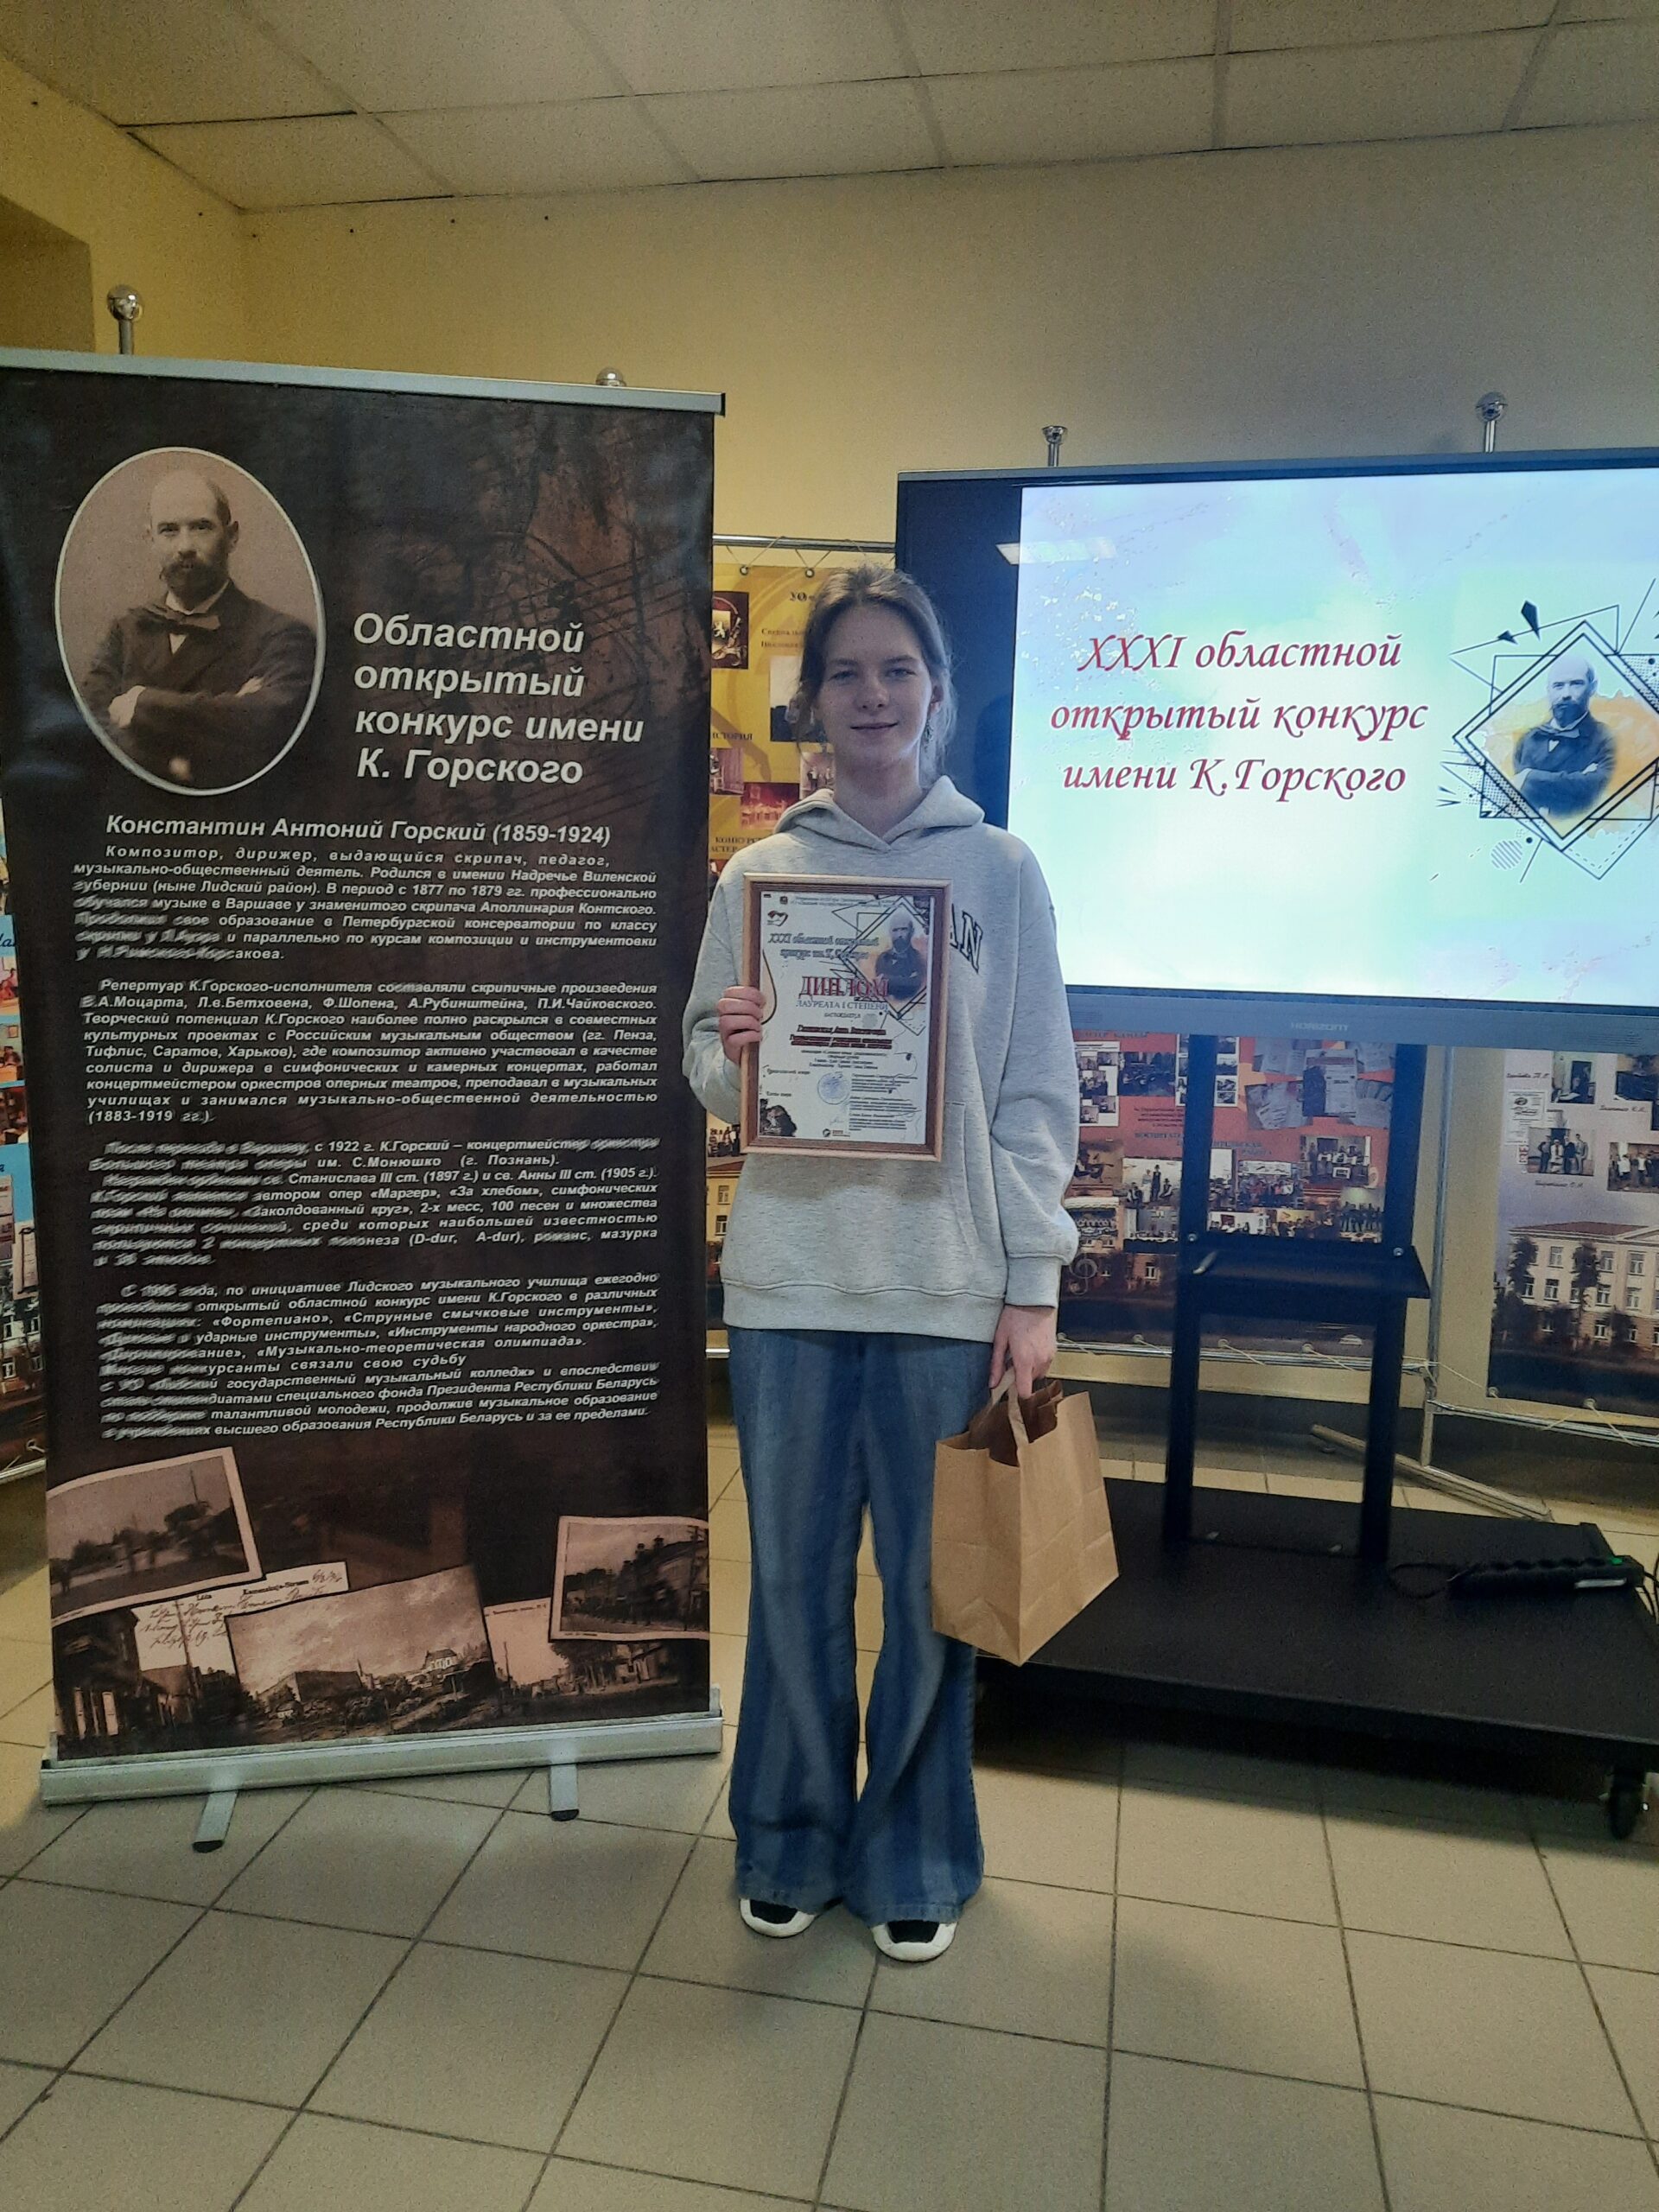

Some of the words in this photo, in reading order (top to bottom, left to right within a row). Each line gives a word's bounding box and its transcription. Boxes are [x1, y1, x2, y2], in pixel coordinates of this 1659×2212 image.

[353, 613, 585, 652] Областной
[1077, 634, 1187, 671] XXXI
[1195, 630, 1402, 668] областной
[353, 664, 586, 699] открытый
[355, 710, 513, 745] конкурс
[525, 716, 644, 743] имени
[1051, 698, 1261, 741] открытый
[1273, 704, 1428, 741] конкурс
[357, 747, 390, 778] К.
[404, 749, 583, 787] Горского
[1063, 766, 1177, 789] имени
[1190, 759, 1406, 802] К.Горского
[106, 815, 264, 835] Константин
[270, 817, 383, 838] Антоний
[390, 820, 486, 843] Горский
[493, 823, 610, 848] (1859-1924)
[105, 845, 223, 861] Композитор,
[235, 847, 316, 862] дирижер,
[328, 849, 443, 863] выдающийся
[454, 854, 526, 866] скрипач,
[537, 853, 609, 868] педагог,
[73, 863, 289, 876] музыкально-общественный
[296, 864, 363, 877] деятель.
[370, 866, 431, 878] Родился
[452, 870, 505, 880] имении
[510, 868, 577, 883] Надречье
[582, 870, 656, 882] Виленской
[200, 880, 262, 892] Лидский
[341, 882, 393, 896] период
[530, 886, 657, 899] профессионально
[151, 899, 207, 911] музыке
[225, 897, 291, 912] Варшаве
[308, 901, 406, 911] знаменитого
[410, 902, 475, 913] скрипача
[480, 901, 574, 915] Аполлинария
[219, 913, 314, 927] образование
[342, 915, 455, 930] Петербургской
[464, 919, 575, 931] консерватории
[610, 921, 657, 932] классу
[243, 933, 340, 944] параллельно
[370, 935, 422, 946] курсам
[428, 935, 513, 946] композиции
[535, 937, 657, 948] инструментовки
[471, 983, 556, 995] скрипичные
[560, 982, 657, 995] произведения
[798, 976, 889, 1001] ДИПЛОМ
[197, 996, 312, 1009] Л.в.Бетховена,
[322, 996, 397, 1010] Ф.Шопена,
[407, 997, 527, 1010] А.Рубинштейна,
[537, 997, 656, 1008] П.И.Чайковского.
[83, 1012, 168, 1026] Творческий
[175, 1015, 258, 1026] потенциал
[264, 1013, 345, 1027] К.Горского
[350, 1013, 417, 1024] наиболее
[423, 1015, 467, 1024] полно
[472, 1015, 549, 1027] раскрылся
[83, 1031, 177, 1042] культурных
[187, 1032, 258, 1042] проектах
[285, 1029, 372, 1039] Российским
[379, 1032, 481, 1043] музыкальным
[490, 1029, 574, 1042] обществом
[86, 1045, 146, 1058] Тифлис,
[153, 1045, 221, 1058] Саратов,
[226, 1046, 296, 1059] Харьков),
[332, 1047, 421, 1058] композитор
[424, 1047, 486, 1056] активно
[490, 1047, 575, 1058] участвовал
[86, 1064, 152, 1072] солиста
[181, 1061, 253, 1075] дирижера
[283, 1061, 399, 1074] симфонических
[426, 1063, 498, 1074] камерных
[506, 1063, 587, 1073] концертах,
[594, 1059, 657, 1073] работал
[86, 1077, 236, 1091] концертмейстером
[240, 1079, 321, 1091] оркестров
[325, 1079, 388, 1090] оперных
[391, 1079, 461, 1090] театров,
[465, 1076, 548, 1090] преподавал
[563, 1077, 658, 1089] музыкальных
[86, 1096, 170, 1108] училищах
[200, 1096, 287, 1105] занимался
[297, 1092, 520, 1106] музыкально-общественной
[530, 1091, 658, 1103] деятельностью
[88, 1109, 172, 1124] (1883-1919
[378, 1138, 450, 1154] К.Горский
[352, 1156, 441, 1167] С.Монюшко
[487, 1154, 559, 1166] Познань).
[288, 1173, 376, 1185] Станислава
[370, 1187, 440, 1200] «Маргер»,
[480, 1185, 543, 1197] хлебом»,
[550, 1183, 658, 1196] симфонических
[519, 1202, 559, 1211] песен
[580, 1199, 657, 1209] множества
[302, 1218, 348, 1232] среди
[358, 1220, 429, 1231] которых
[438, 1215, 533, 1227] наибольшей
[543, 1214, 658, 1225] известностью
[600, 1229, 657, 1240] мазурка
[251, 1283, 340, 1295] инициативе
[346, 1281, 413, 1291] Лидского
[420, 1279, 520, 1292] музыкального
[526, 1277, 588, 1289] училища
[594, 1272, 658, 1284] ежегодно
[288, 1296, 366, 1308] областной
[374, 1296, 430, 1308] конкурс
[437, 1294, 480, 1304] имени
[487, 1291, 562, 1304] К.Горского
[584, 1288, 658, 1302] различных
[213, 1314, 333, 1328] «Фортепиано»,
[344, 1312, 432, 1325] «Струнные
[442, 1308, 529, 1319] смычковые
[538, 1304, 657, 1318] инструменты»,
[194, 1331, 257, 1344] ударные
[264, 1329, 379, 1341] инструменты»,
[387, 1324, 498, 1337] «Инструменты
[504, 1320, 575, 1334] народного
[582, 1319, 656, 1332] оркестра»,
[257, 1338, 485, 1357] «Музыкально-теоретическая
[493, 1335, 586, 1347] олимпиада».
[290, 1360, 353, 1370] связали
[412, 1352, 467, 1369] судьбу
[226, 1374, 356, 1390] государственный
[365, 1369, 461, 1385] музыкальный
[469, 1366, 535, 1377] колледж»
[276, 1390, 374, 1402] специального
[378, 1386, 423, 1400] фонда
[426, 1382, 511, 1397] Президента
[513, 1380, 593, 1393] Республики
[595, 1377, 658, 1389] Беларусь
[211, 1404, 311, 1419] талантливой
[317, 1403, 390, 1414] молодежи,
[396, 1400, 473, 1414] продолжив
[478, 1397, 569, 1409] музыкальное
[573, 1392, 658, 1407] образование
[213, 1424, 278, 1434] высшего
[282, 1420, 372, 1433] образования
[374, 1415, 455, 1429] Республики
[459, 1412, 523, 1424] Беларусь
